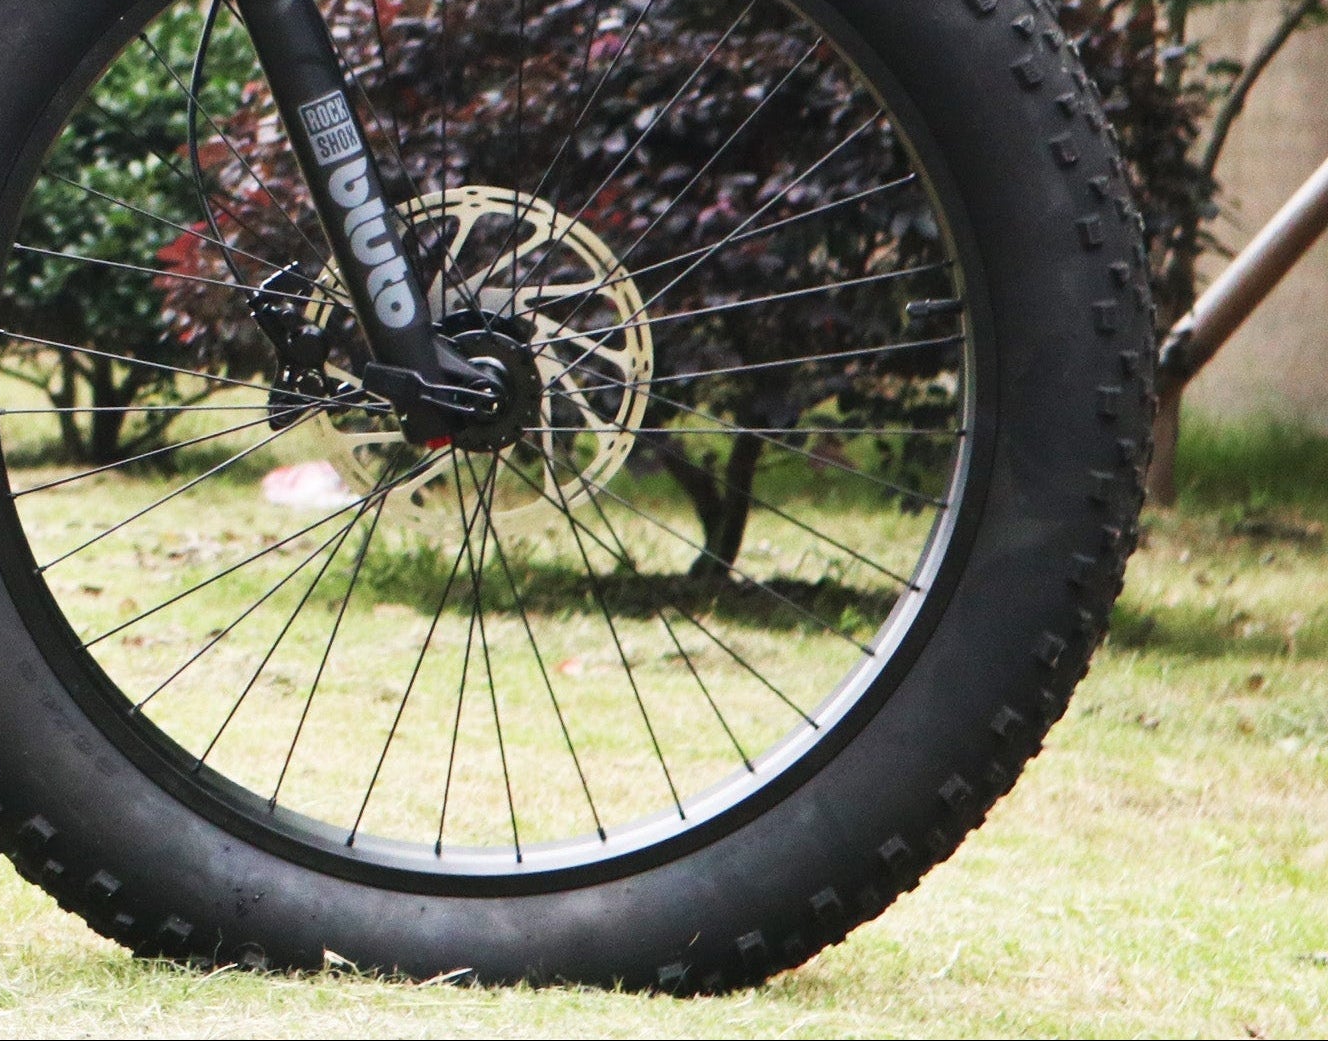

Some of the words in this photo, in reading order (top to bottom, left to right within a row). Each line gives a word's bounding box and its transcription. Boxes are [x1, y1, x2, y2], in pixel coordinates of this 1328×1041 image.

[305, 96, 349, 133] ROCK
[317, 126, 359, 159] SHOX
[328, 156, 415, 329] bluto
